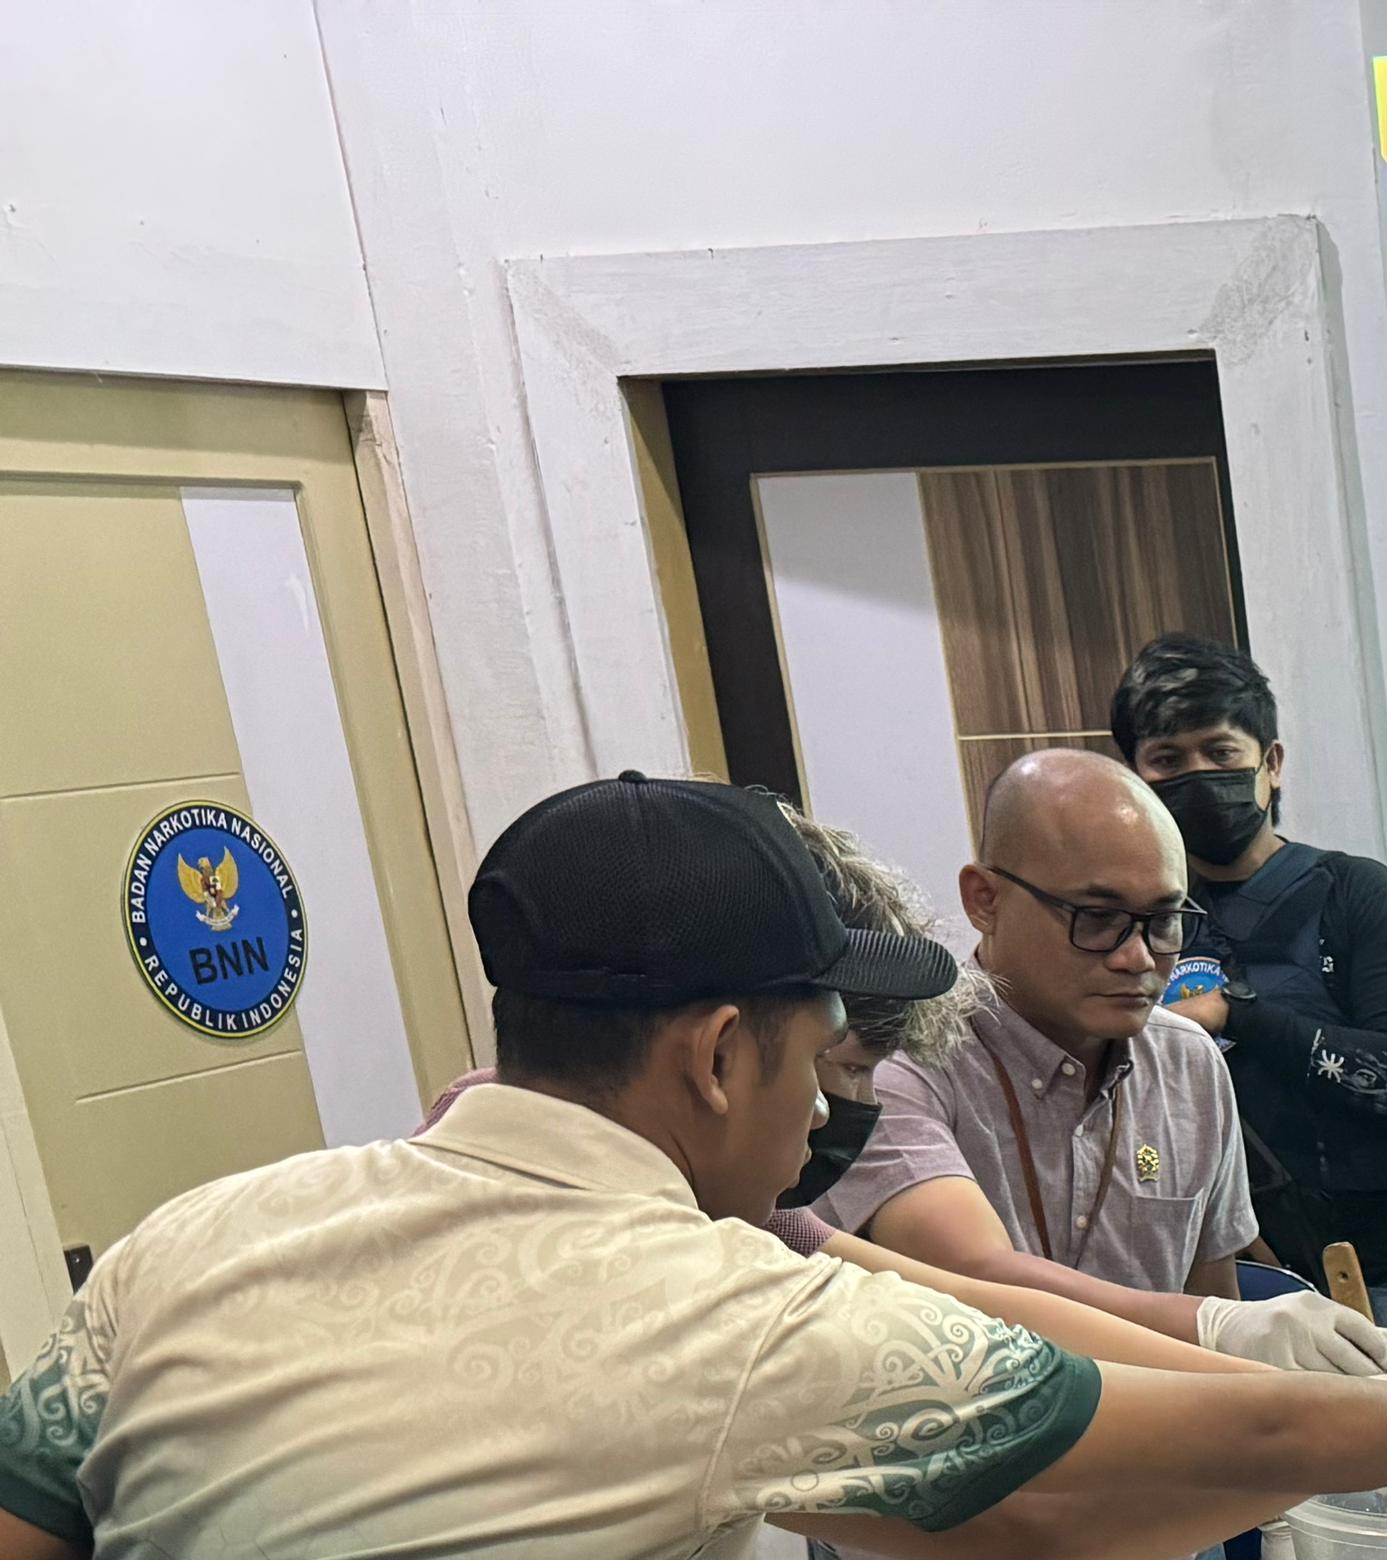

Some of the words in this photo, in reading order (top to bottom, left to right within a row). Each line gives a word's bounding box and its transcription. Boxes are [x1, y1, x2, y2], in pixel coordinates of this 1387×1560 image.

[131, 854, 152, 923] BADAN
[144, 808, 227, 858] NARKOTIKA
[231, 818, 294, 899] NASIONAL
[145, 955, 238, 1031] REPUBLIK
[241, 929, 303, 1029] INDONESIA
[189, 936, 270, 985] BNN
